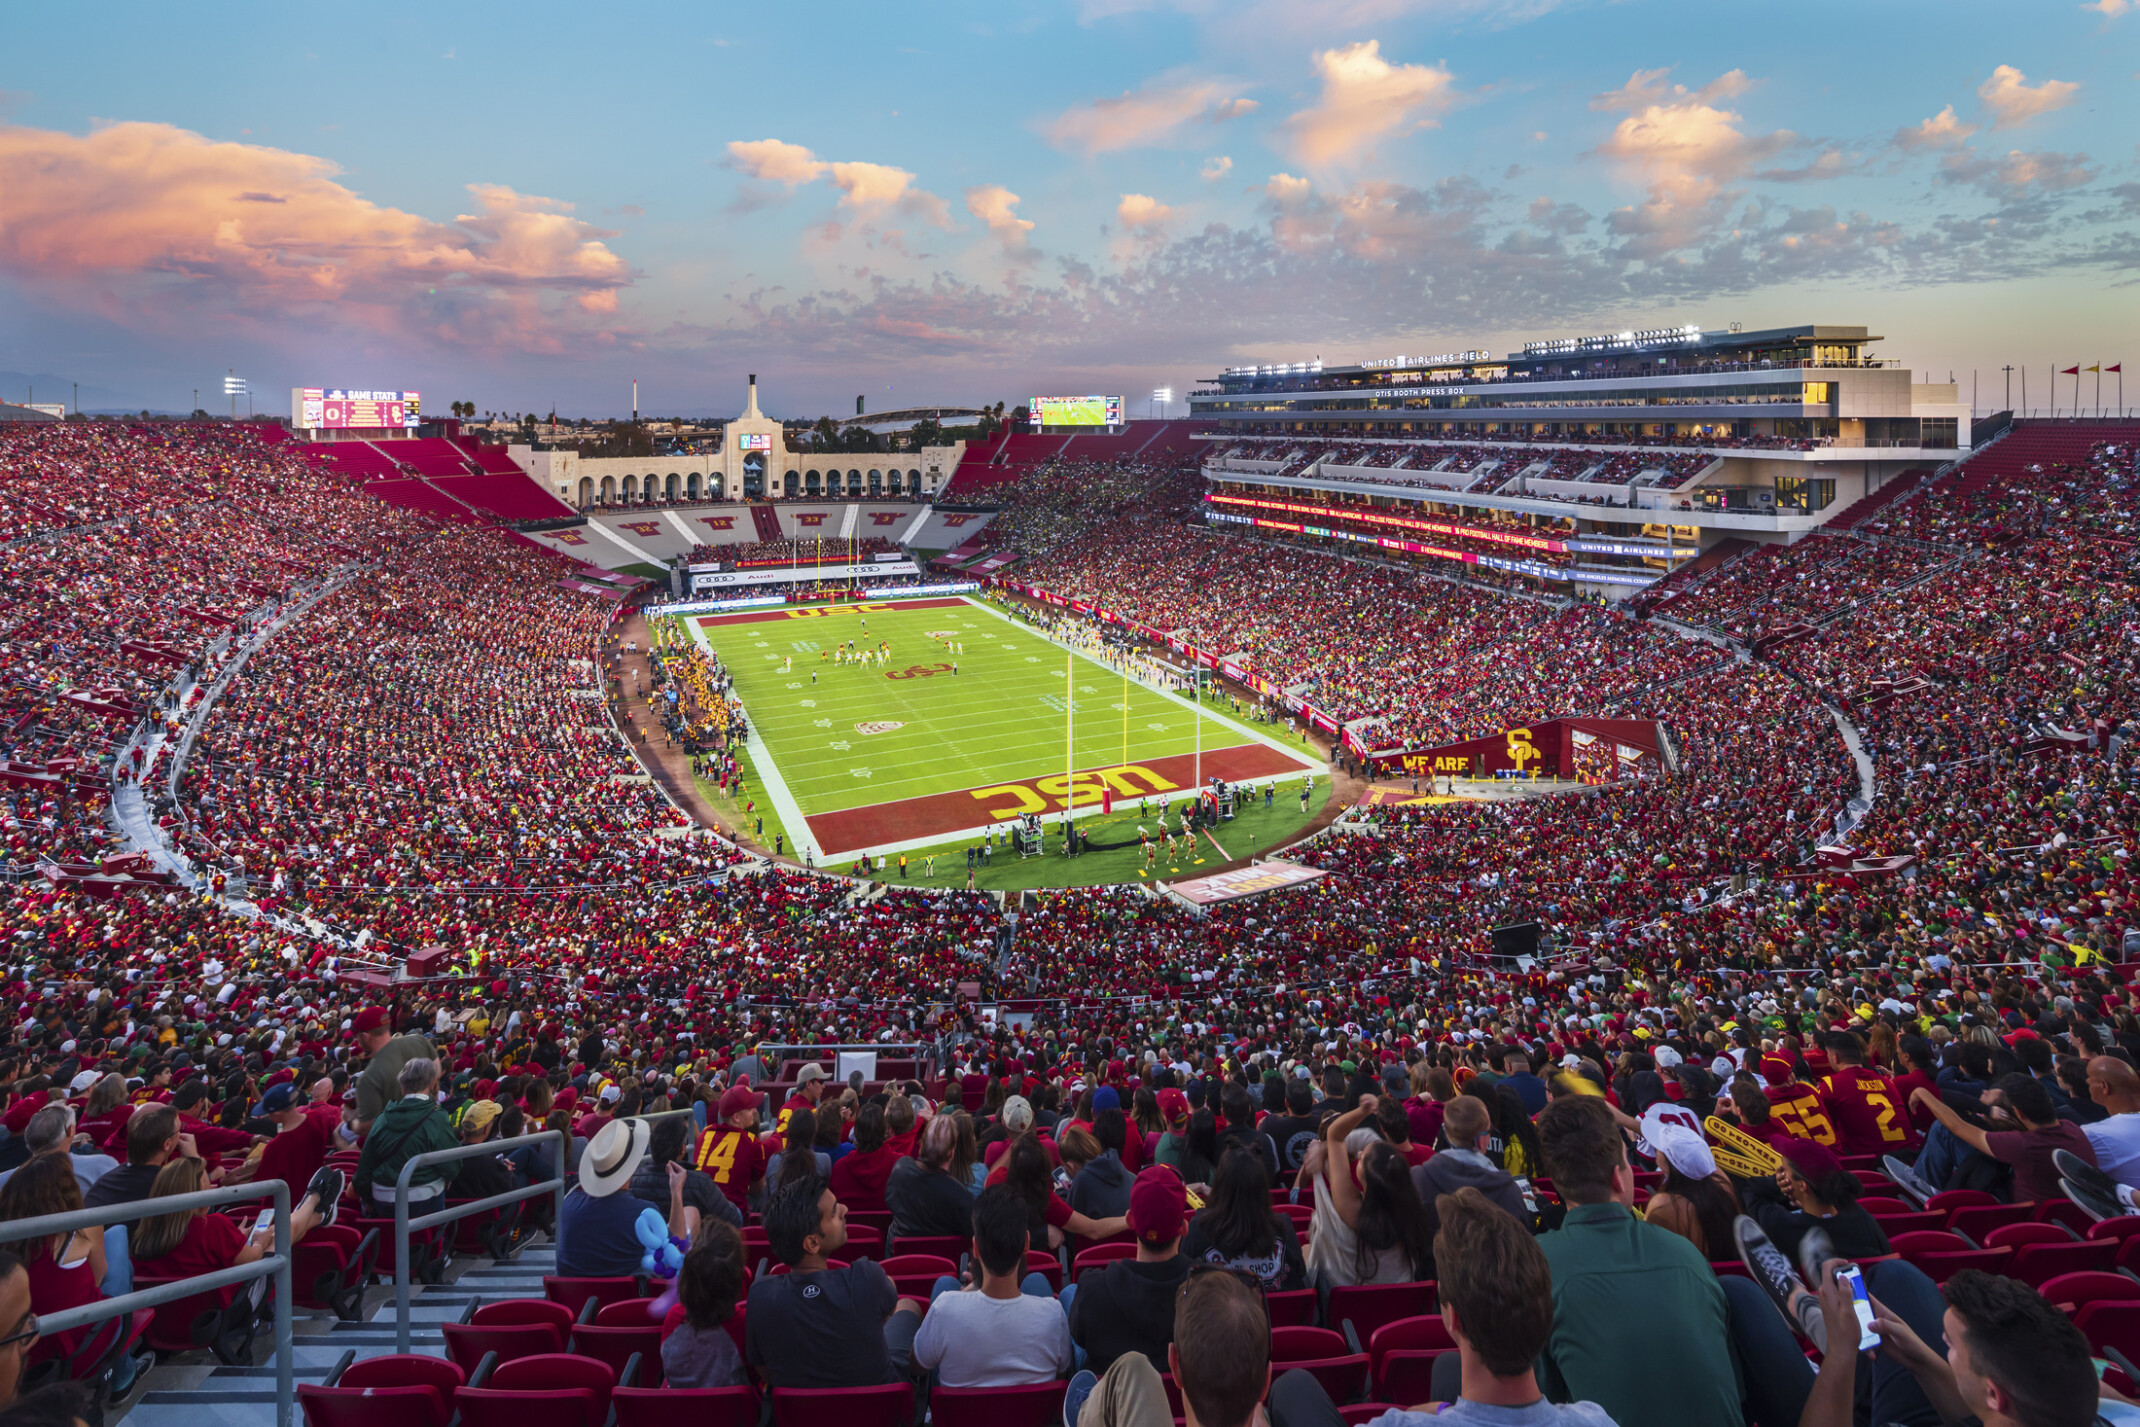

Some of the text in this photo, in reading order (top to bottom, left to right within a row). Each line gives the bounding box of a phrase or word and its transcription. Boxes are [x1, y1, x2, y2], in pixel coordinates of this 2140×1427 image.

[1361, 350, 1490, 368] UNITED AIRLINES FIELD
[348, 391, 397, 400] GAME STATS
[1386, 517, 1404, 525] FOOTBALL
[1432, 524, 1452, 533] MEMBERS
[1470, 529, 1491, 540] FOOTBALL
[1492, 533, 1504, 541] HALL
[1511, 536, 1524, 545] FAME
[1524, 538, 1548, 549] MEMBERS
[1425, 547, 1442, 556] HEISMAN
[1443, 550, 1462, 560] WINNERS
[784, 604, 895, 618] USC
[1402, 755, 1469, 771] WE ARE
[969, 765, 1180, 820] USC
[1193, 868, 1273, 887] MILK
[1855, 1078, 1888, 1091] JACKSON
[1769, 1094, 1836, 1147] 55
[1865, 1093, 1906, 1142] 2
[1713, 1122, 1776, 1164] GO TROJANS
[696, 1130, 741, 1184] 14
[1714, 1154, 1767, 1176] FIGHT ON
[1250, 1263, 1274, 1274] SHOP
[103, 1368, 114, 1381] 19
